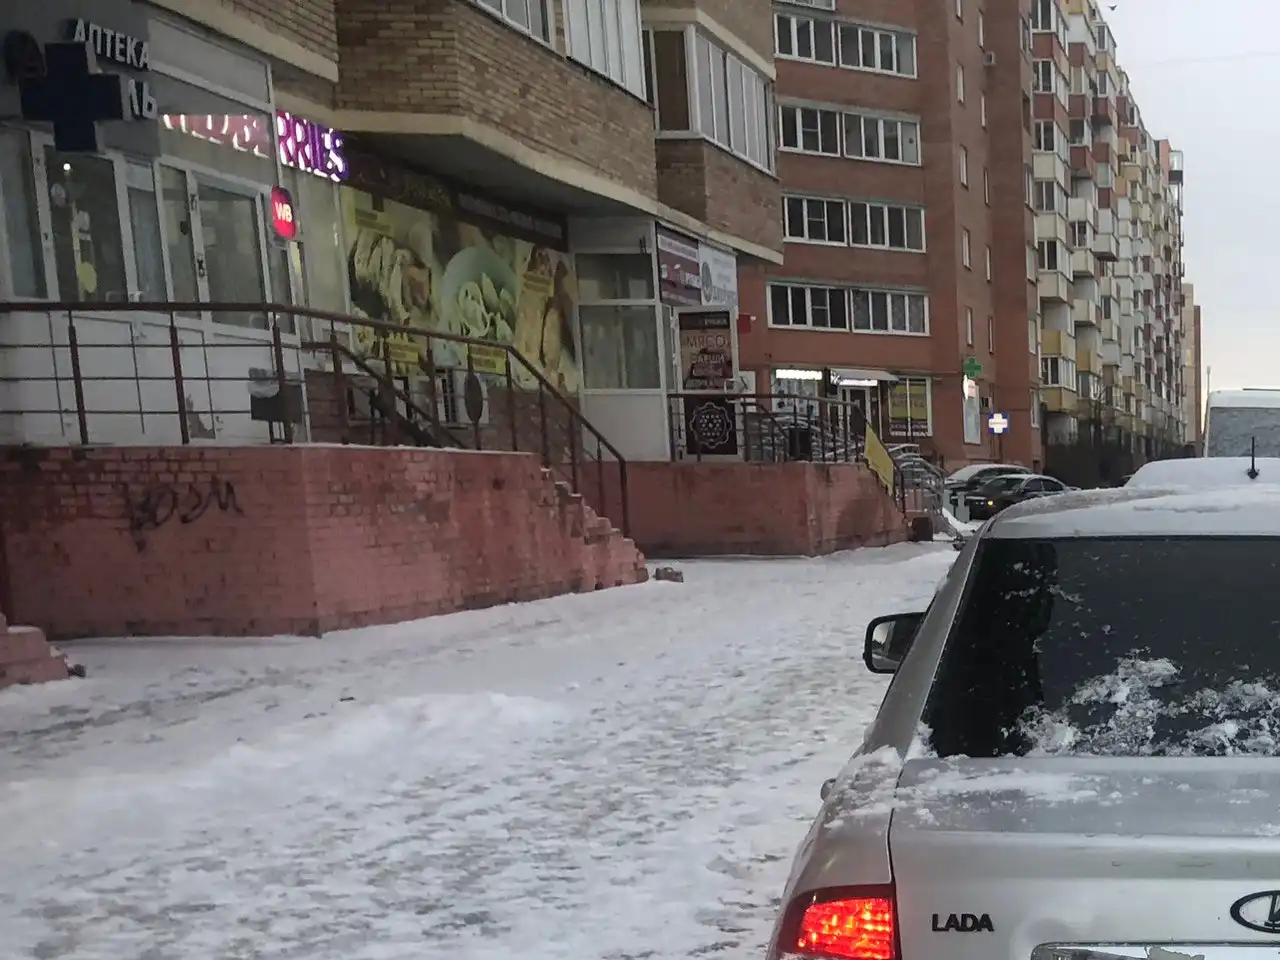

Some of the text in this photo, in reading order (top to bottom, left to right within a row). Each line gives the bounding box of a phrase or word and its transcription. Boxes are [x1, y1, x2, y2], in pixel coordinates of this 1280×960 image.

[73, 18, 152, 71] АПТЕКА
[275, 201, 293, 223] WB
[931, 913, 995, 932] LADA
